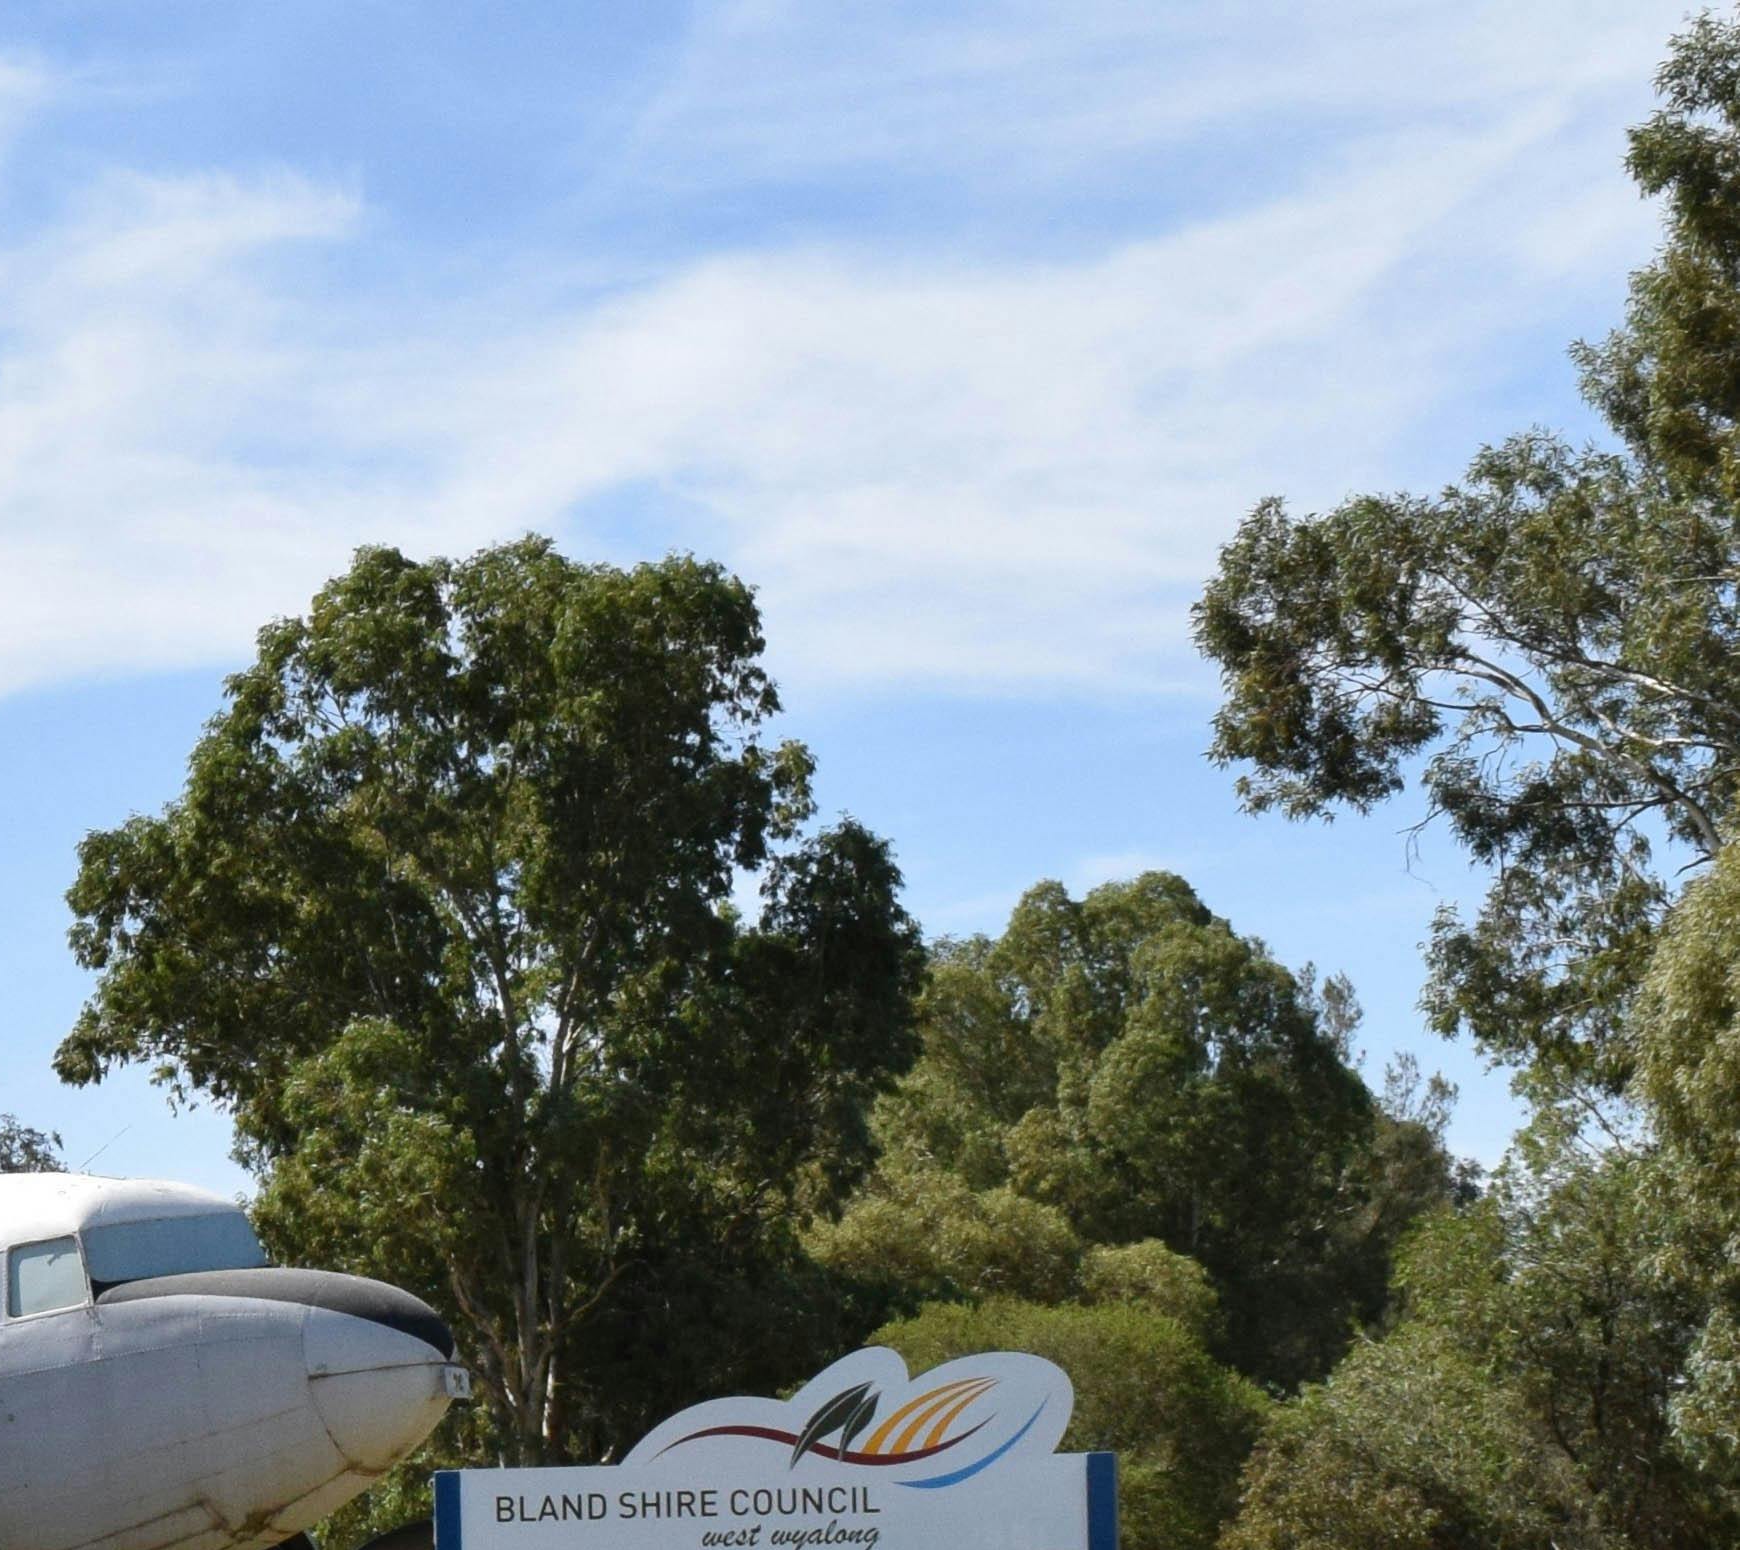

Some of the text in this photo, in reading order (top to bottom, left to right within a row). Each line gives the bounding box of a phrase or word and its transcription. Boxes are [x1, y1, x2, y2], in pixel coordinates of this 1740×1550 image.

[495, 1486, 881, 1523] BLAND SHIRE COUNCIL
[701, 1524, 762, 1547] west
